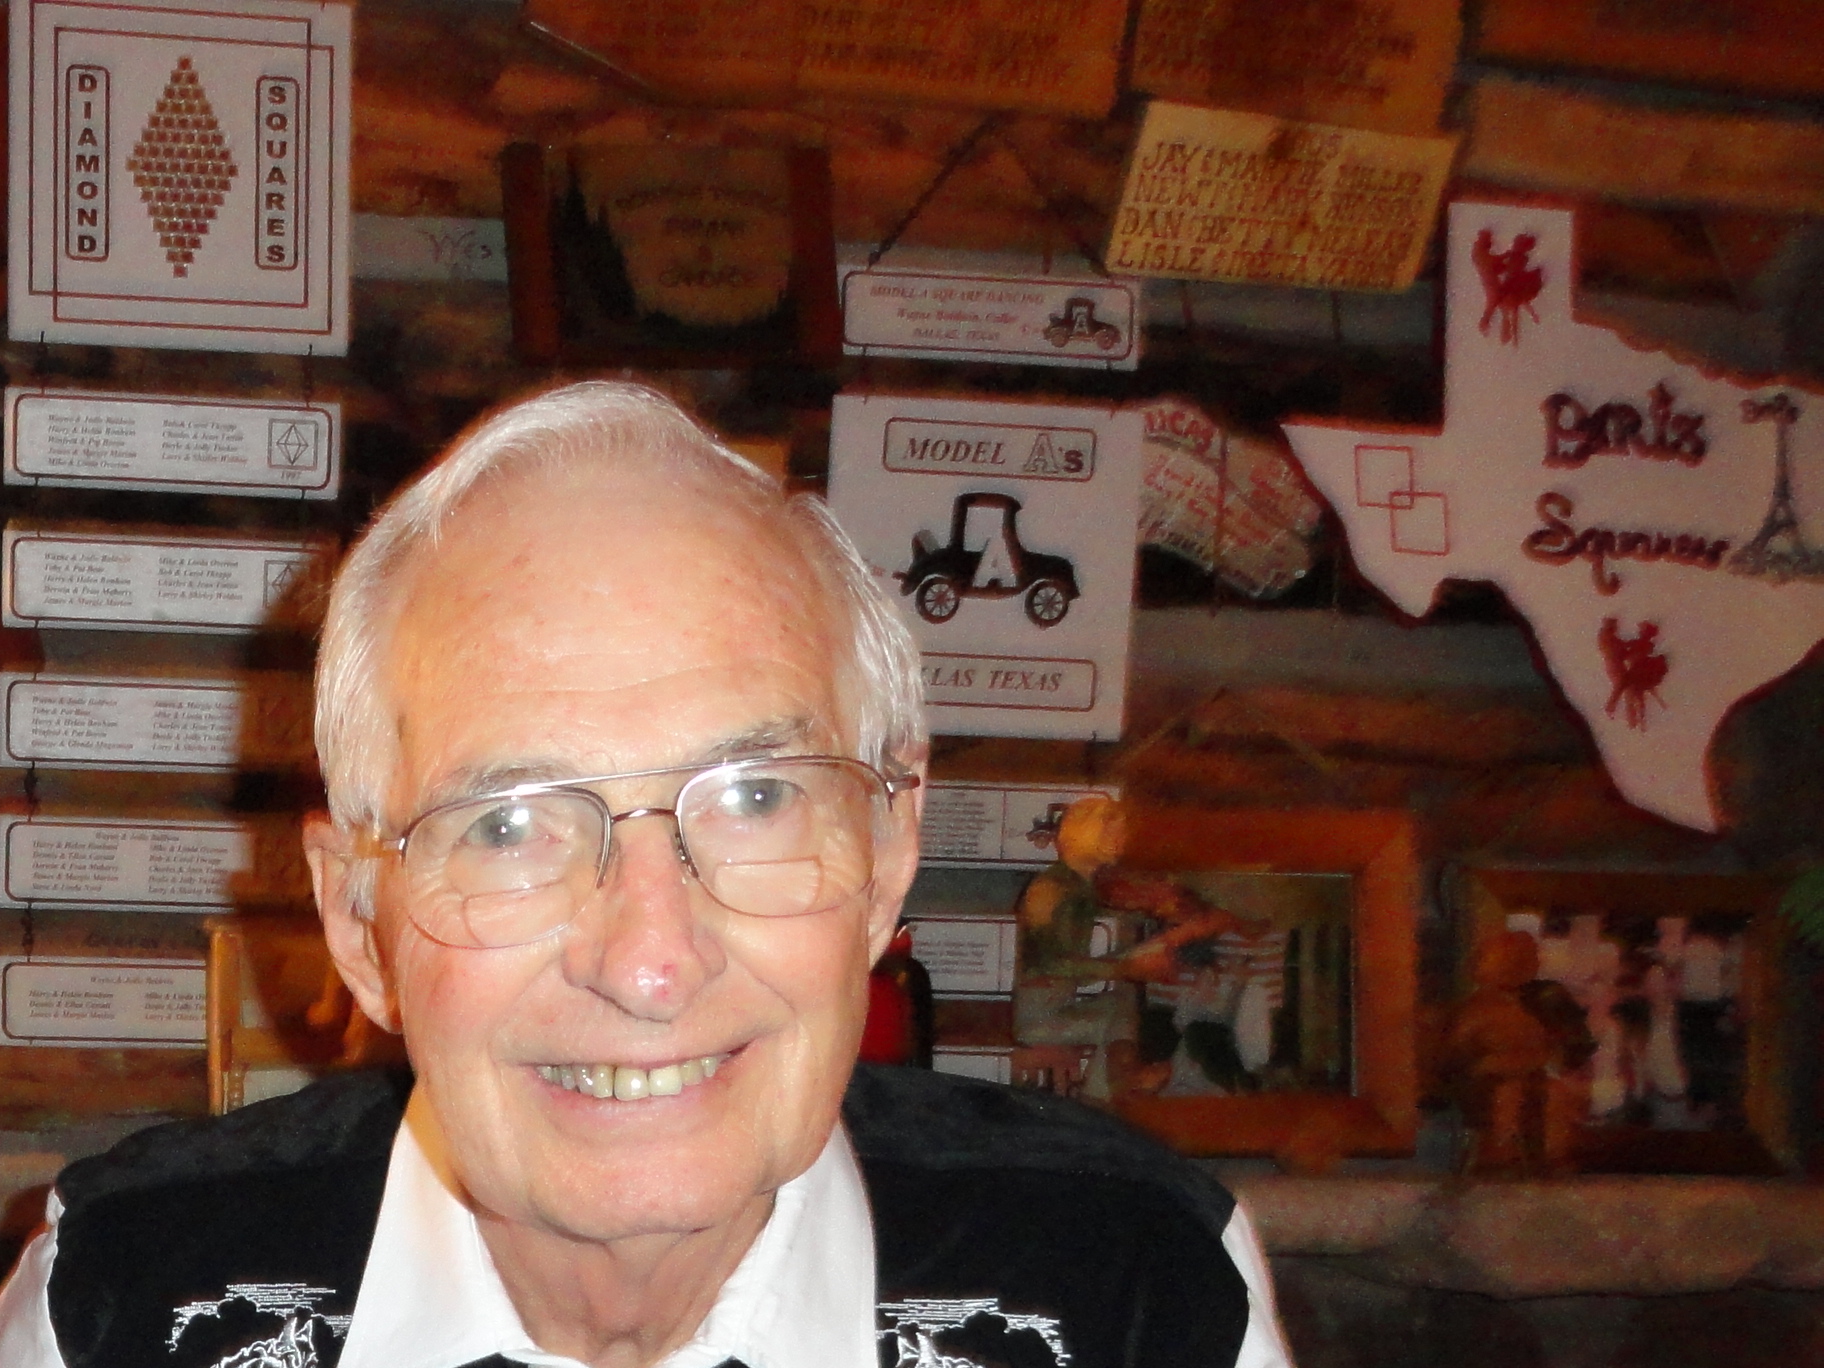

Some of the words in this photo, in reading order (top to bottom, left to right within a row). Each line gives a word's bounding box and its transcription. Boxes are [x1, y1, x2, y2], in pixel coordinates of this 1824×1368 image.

[76, 73, 100, 254] DIAMOND
[265, 86, 288, 264] SQUARES
[904, 437, 1006, 466] MODEL
[988, 669, 1063, 693] TEXAS
